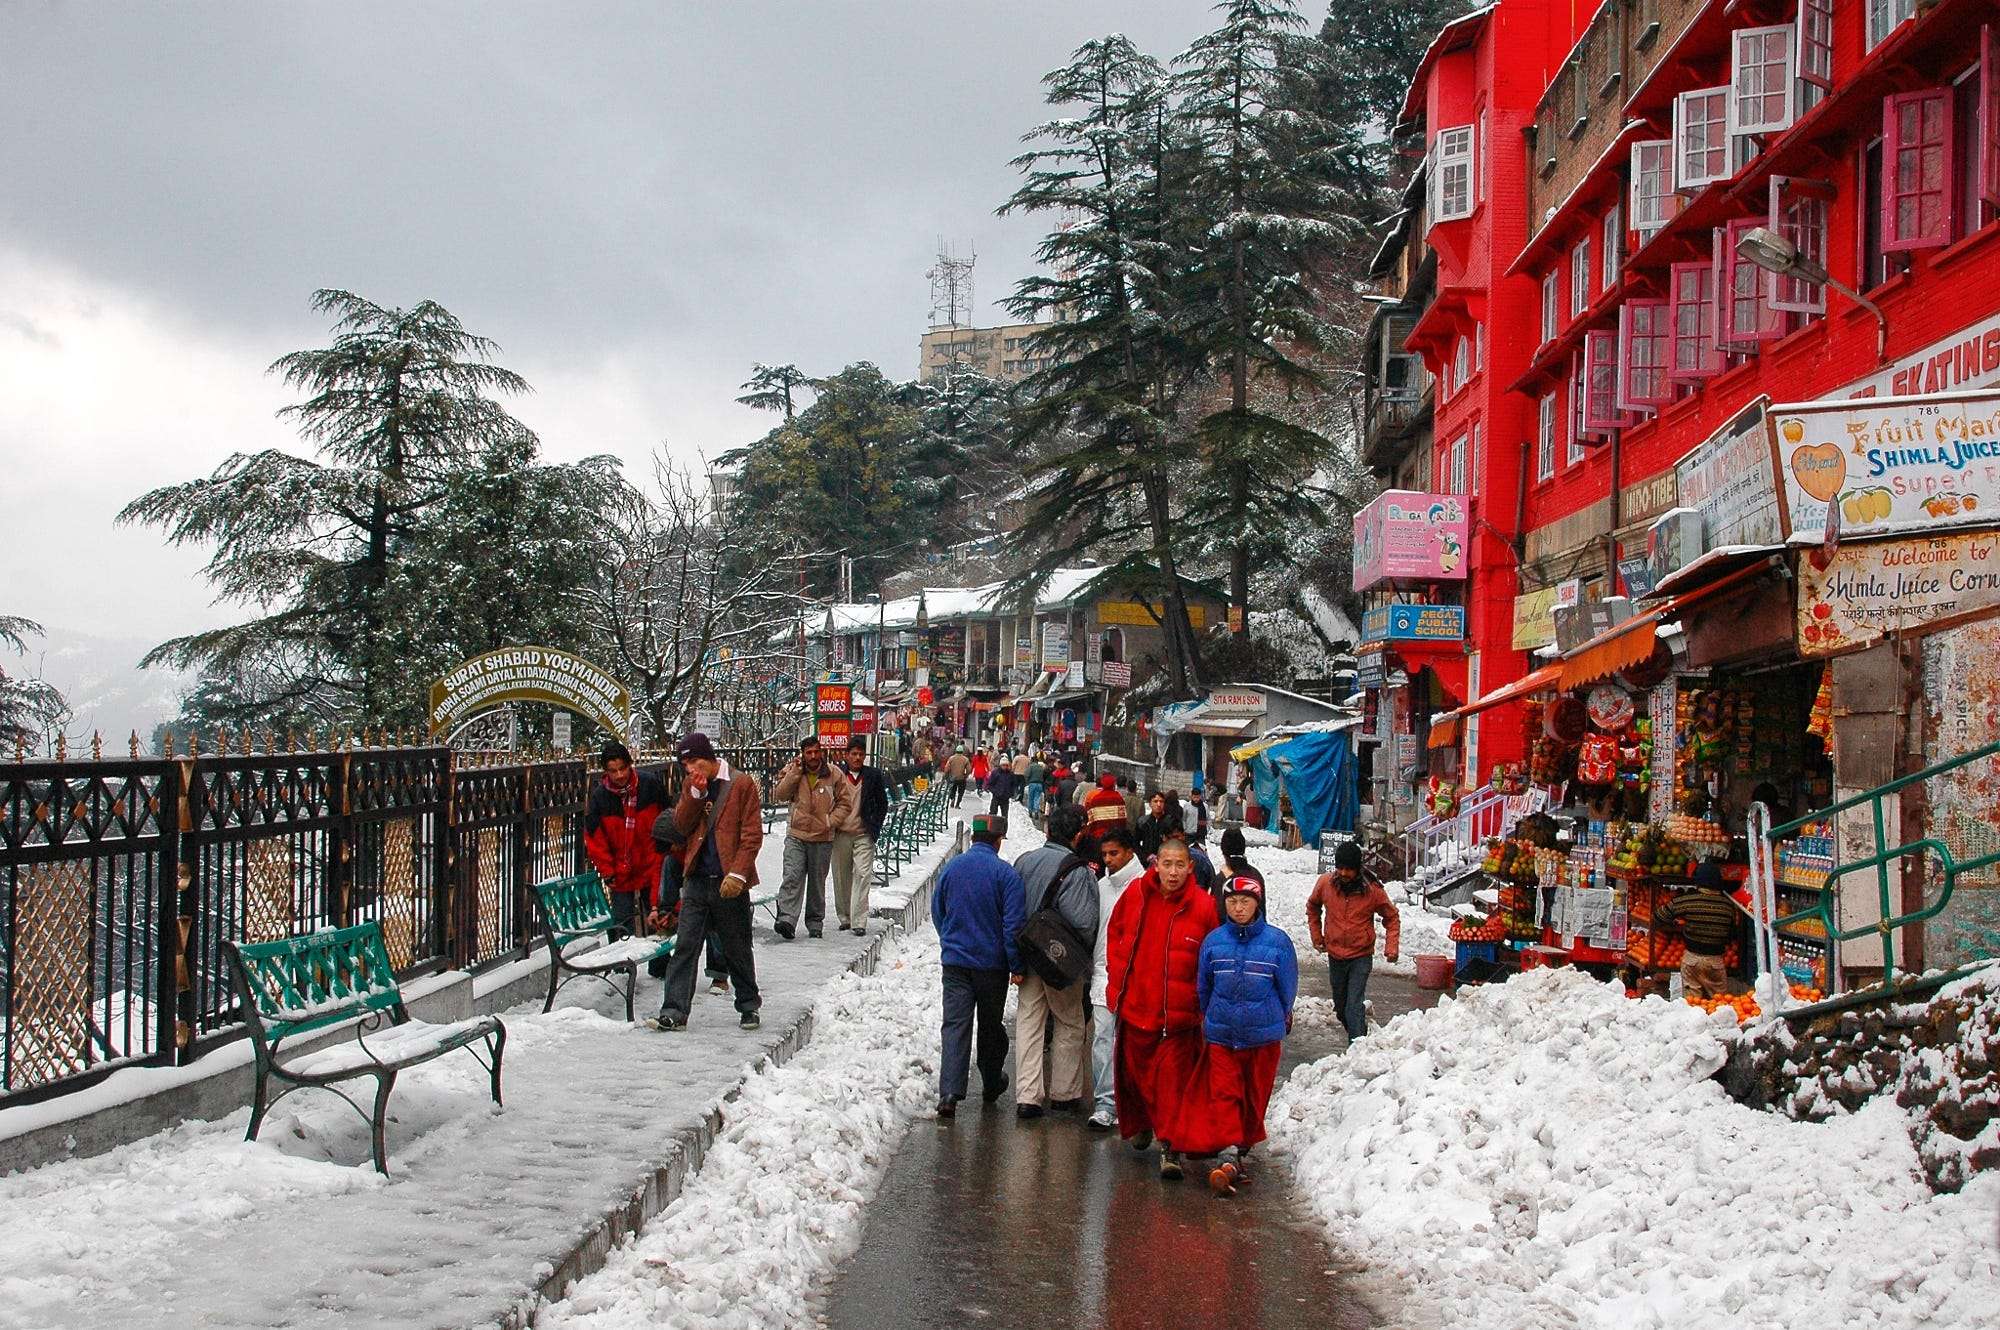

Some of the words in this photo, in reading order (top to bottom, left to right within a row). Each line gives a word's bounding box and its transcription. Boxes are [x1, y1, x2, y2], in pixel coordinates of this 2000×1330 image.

[1892, 328, 2000, 396] SKATING
[1919, 406, 1940, 416] 786
[1846, 416, 1924, 457] Fruit
[1934, 411, 2000, 443] Mar
[1867, 447, 1949, 477] SHIMLA
[1945, 440, 2000, 470] JUICE
[1892, 469, 1974, 495] Super
[1625, 473, 1677, 518] INDO-TIBE
[1882, 547, 1958, 567] Welcome
[1969, 542, 1991, 561] to
[1928, 539, 1947, 549] 786
[1890, 571, 1940, 600] Juice
[1418, 619, 1460, 627] PUBLIC
[1421, 610, 1459, 619] REGAL
[1415, 627, 1459, 636] SCHOOL
[443, 660, 484, 692] SURAT
[484, 651, 541, 671] SHABAD
[543, 652, 572, 672] YOG
[570, 660, 621, 702] MANDIR
[433, 692, 461, 723] RADHA
[458, 675, 487, 699] SOAMI
[485, 668, 516, 685] DAYAL
[527, 666, 549, 680] DAYA
[548, 669, 580, 693] RADHA
[531, 680, 553, 691] BAZAR
[553, 684, 581, 705] SHIMLA
[819, 700, 847, 712] SHOES
